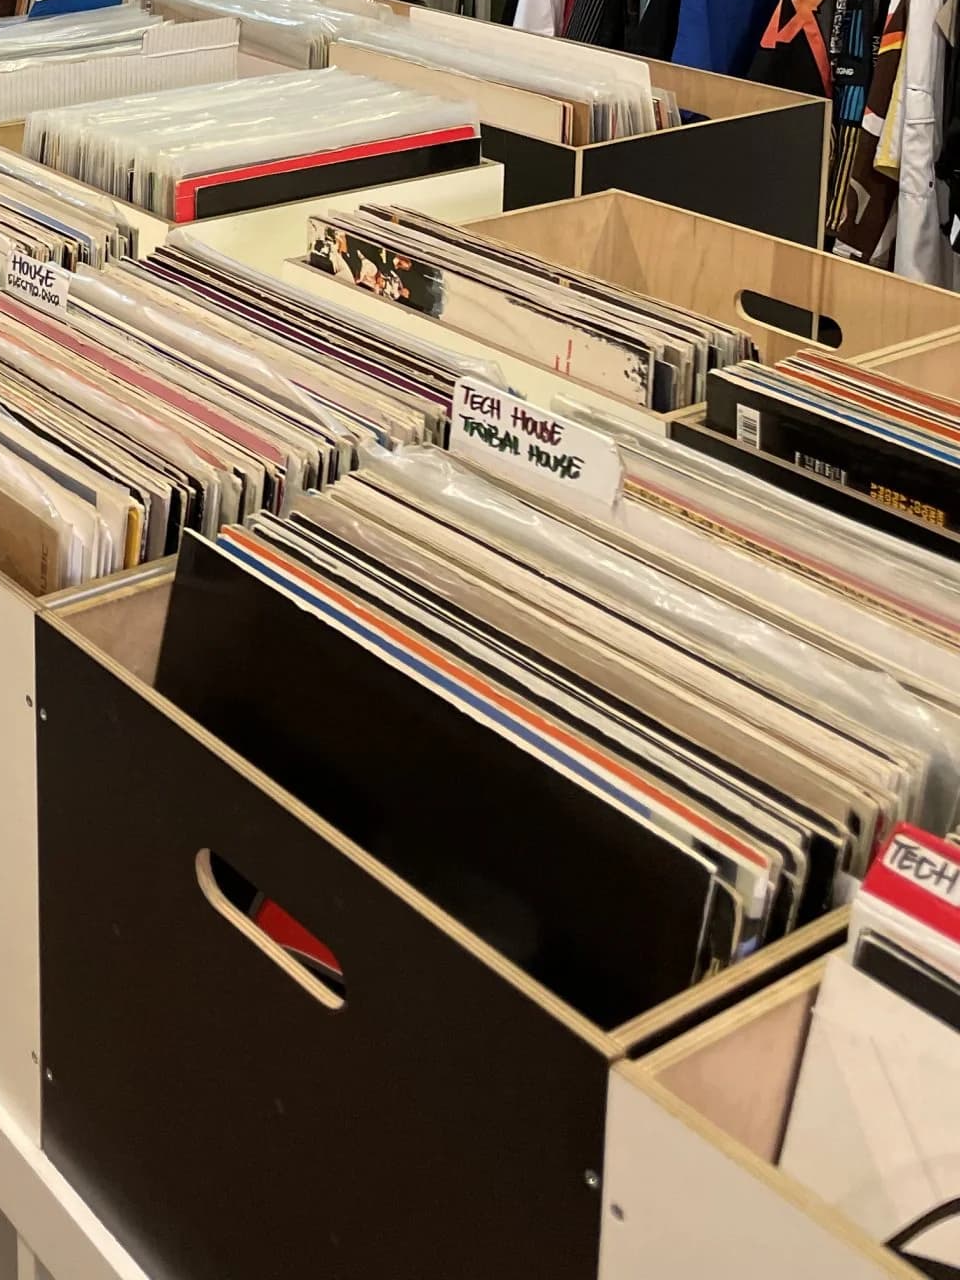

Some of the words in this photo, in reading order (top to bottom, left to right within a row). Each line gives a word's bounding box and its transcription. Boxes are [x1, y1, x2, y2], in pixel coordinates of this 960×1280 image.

[12, 255, 56, 288] HOUSE
[460, 384, 501, 420] TECH
[511, 406, 565, 446] HOUSE
[528, 443, 585, 479] HOUSE
[889, 838, 960, 895] TECH
